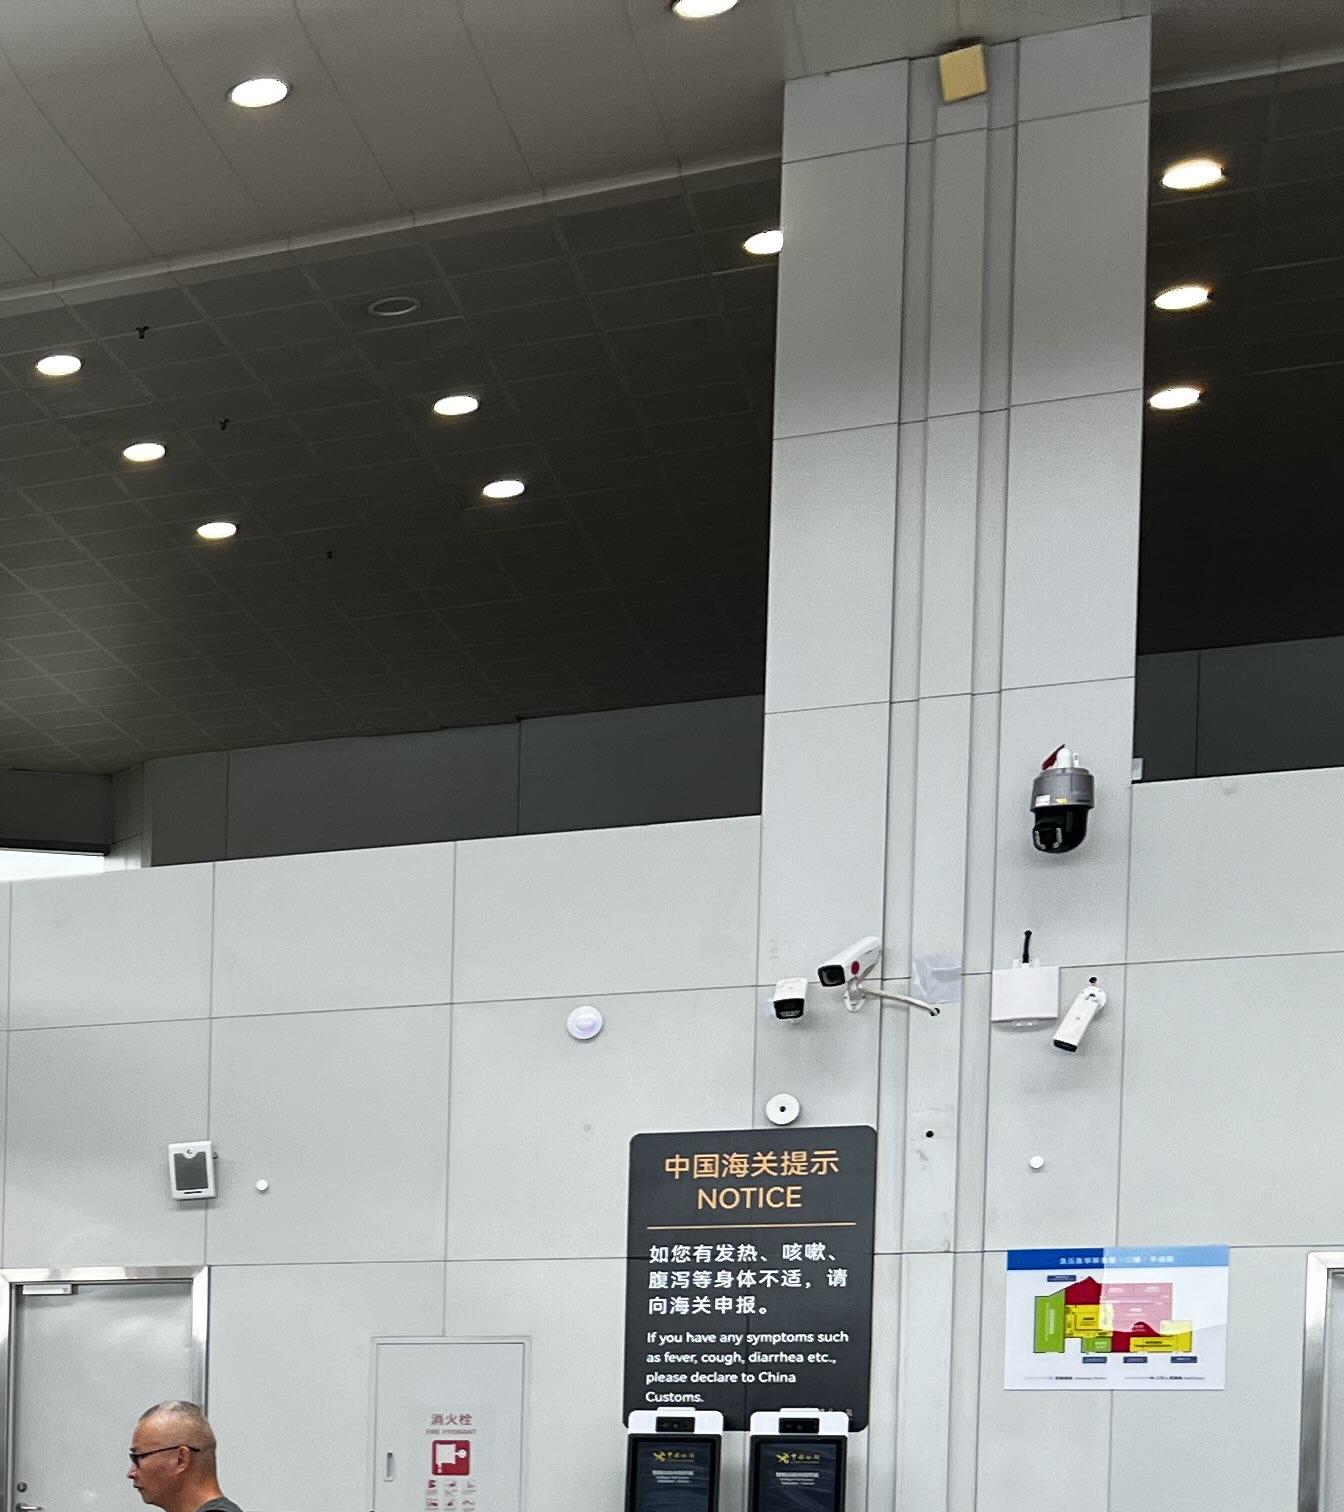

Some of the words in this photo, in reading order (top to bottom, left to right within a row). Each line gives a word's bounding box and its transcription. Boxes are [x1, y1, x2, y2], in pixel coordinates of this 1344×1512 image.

[664, 1149, 840, 1180] 中国海关提示
[697, 1185, 803, 1210] NOTICE
[646, 1332, 657, 1343] If
[659, 1335, 683, 1346] you
[686, 1332, 717, 1343] have
[719, 1334, 744, 1346] any
[746, 1331, 814, 1345] symptoms
[817, 1331, 849, 1343] such
[646, 1354, 661, 1363] as
[664, 1351, 698, 1364] fever,
[701, 1352, 746, 1365] cough,
[748, 1351, 804, 1363] diarrhea
[645, 1372, 688, 1385] please
[690, 1372, 738, 1383] declare
[741, 1373, 756, 1383] to
[758, 1371, 796, 1383] China
[645, 1391, 705, 1403] Customs.
